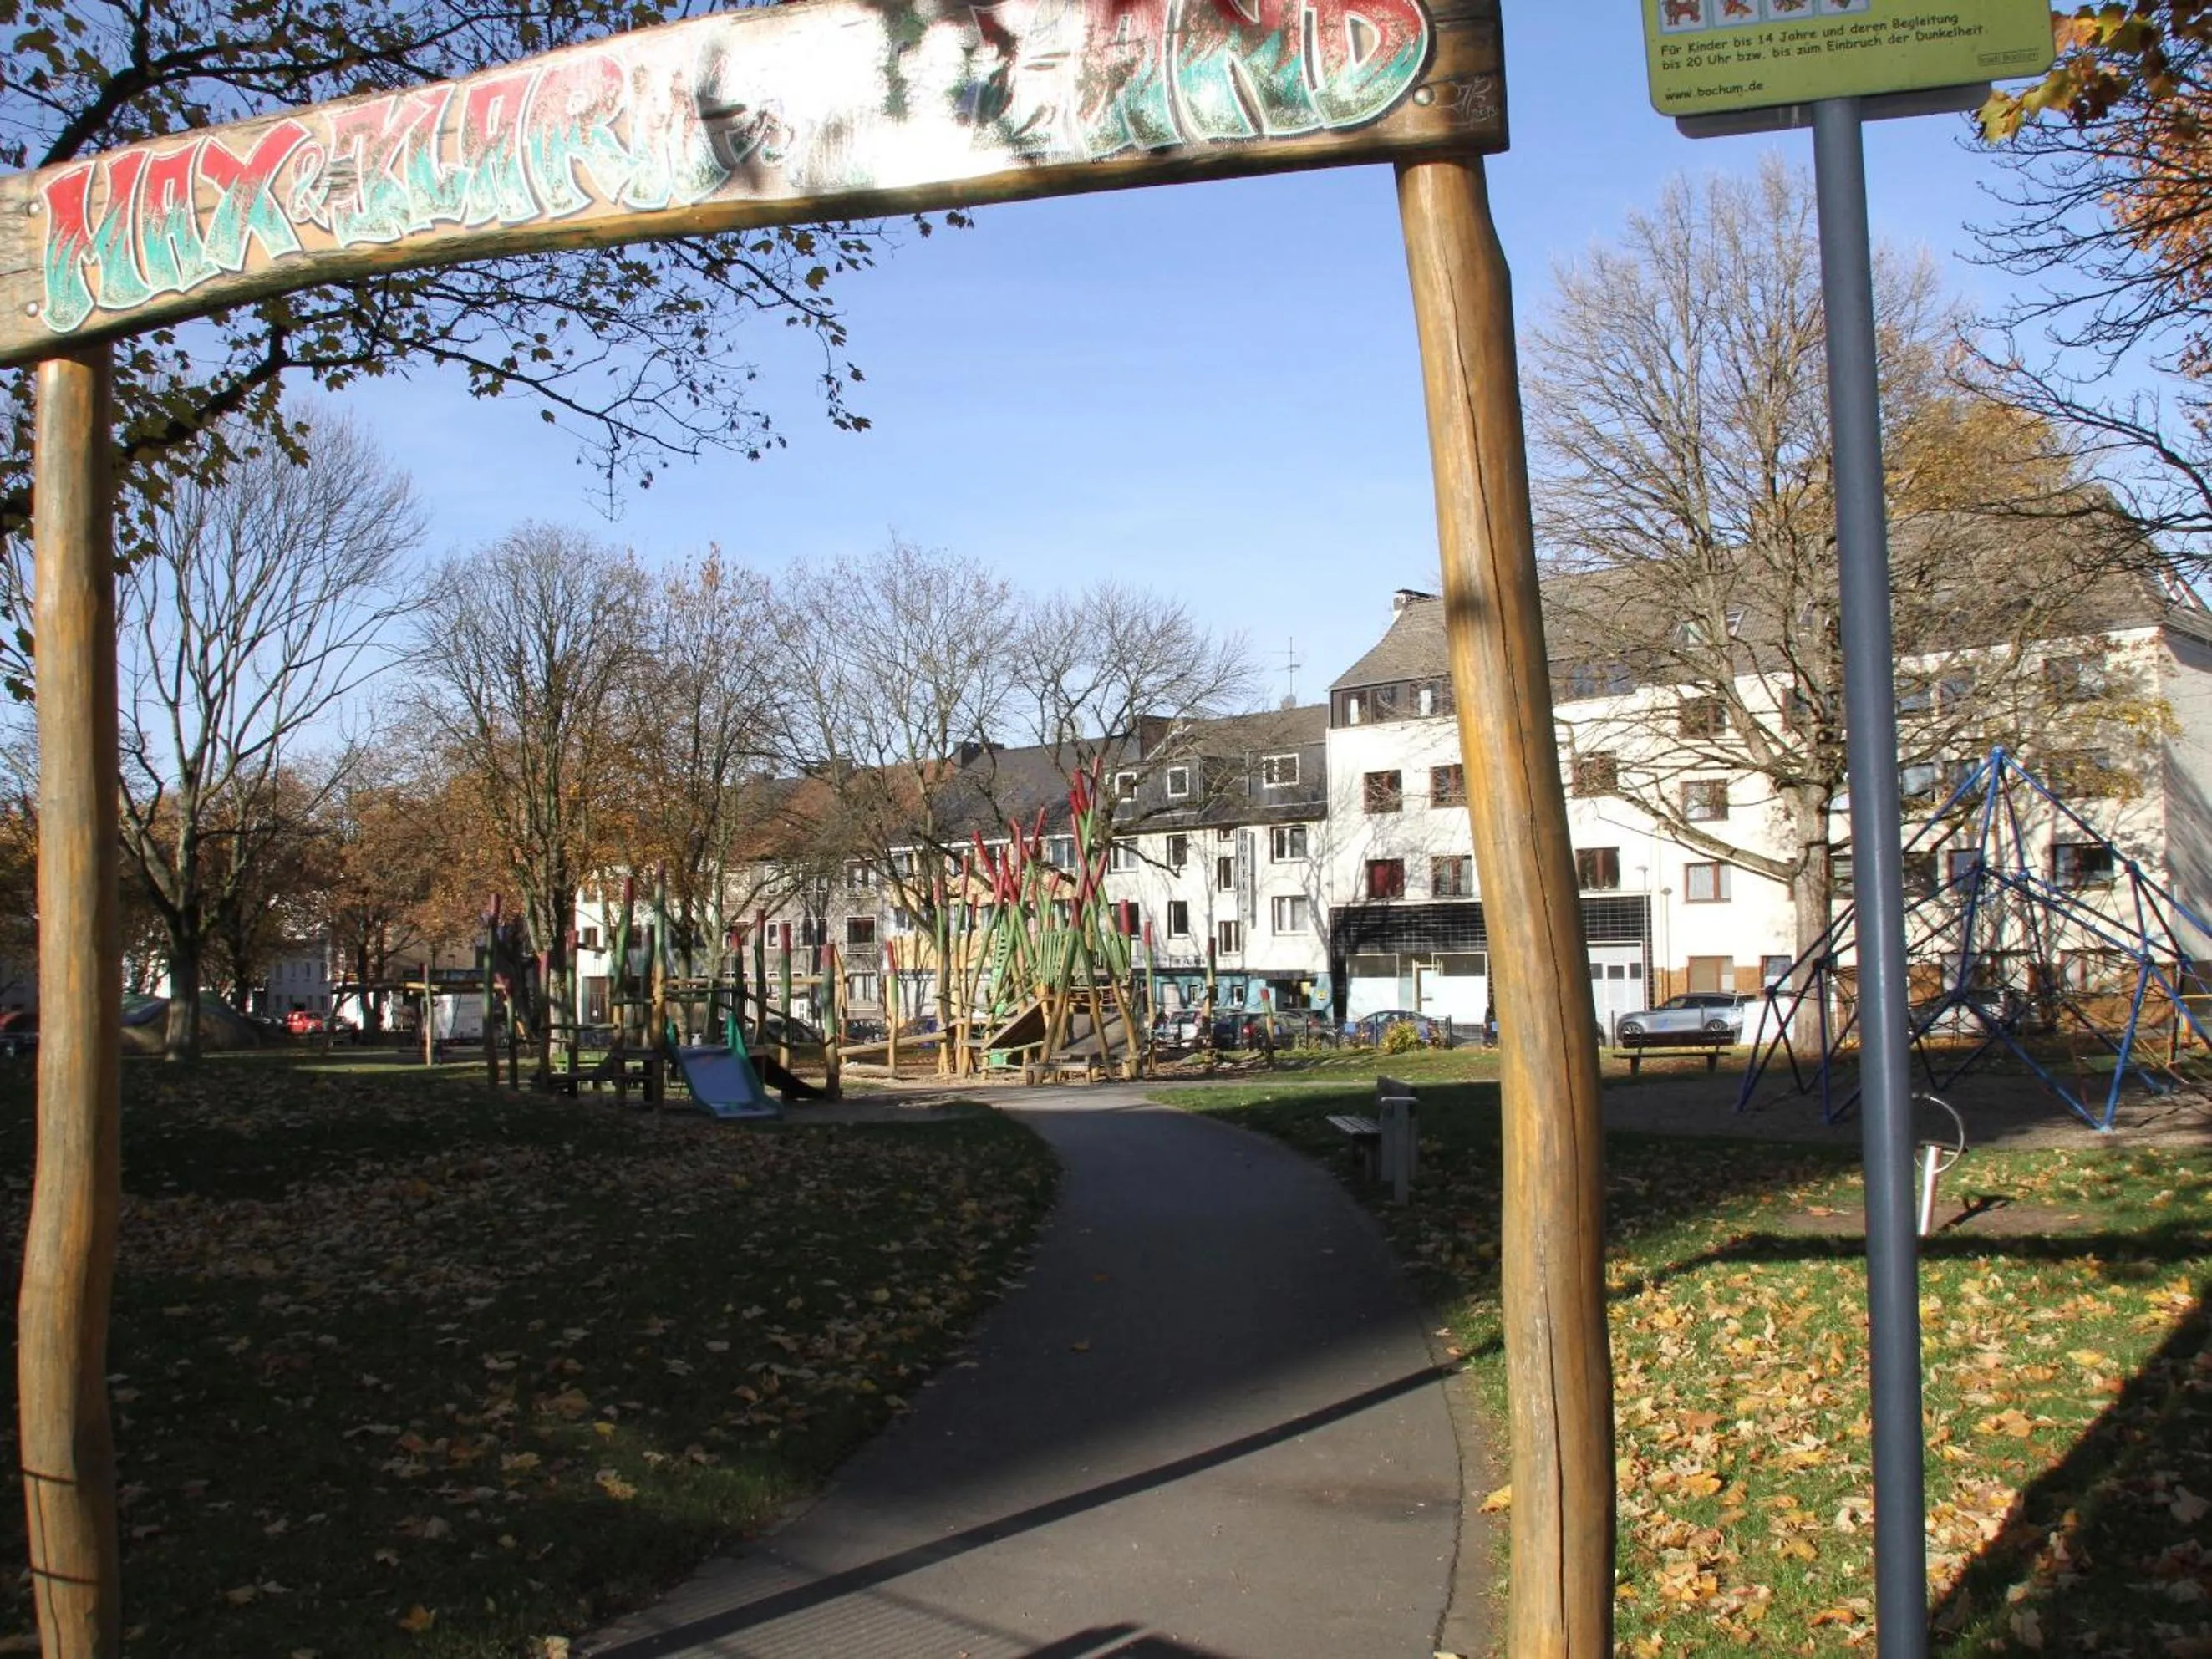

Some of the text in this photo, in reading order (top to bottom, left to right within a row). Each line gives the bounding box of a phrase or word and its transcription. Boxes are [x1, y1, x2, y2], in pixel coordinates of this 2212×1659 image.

[1660, 13, 1960, 56] Für Kinder bis 14 Jahre und deren Begleitung
[1661, 59, 1681, 71] bis
[1686, 55, 1703, 68] 20
[1707, 52, 1732, 65] Uhr
[1737, 49, 1767, 62] bzw.
[1772, 45, 1791, 59] bis
[1796, 43, 1822, 56] zum
[1826, 35, 1883, 52] Einbruch
[1887, 32, 1910, 44] der
[40, 117, 314, 333] MAX
